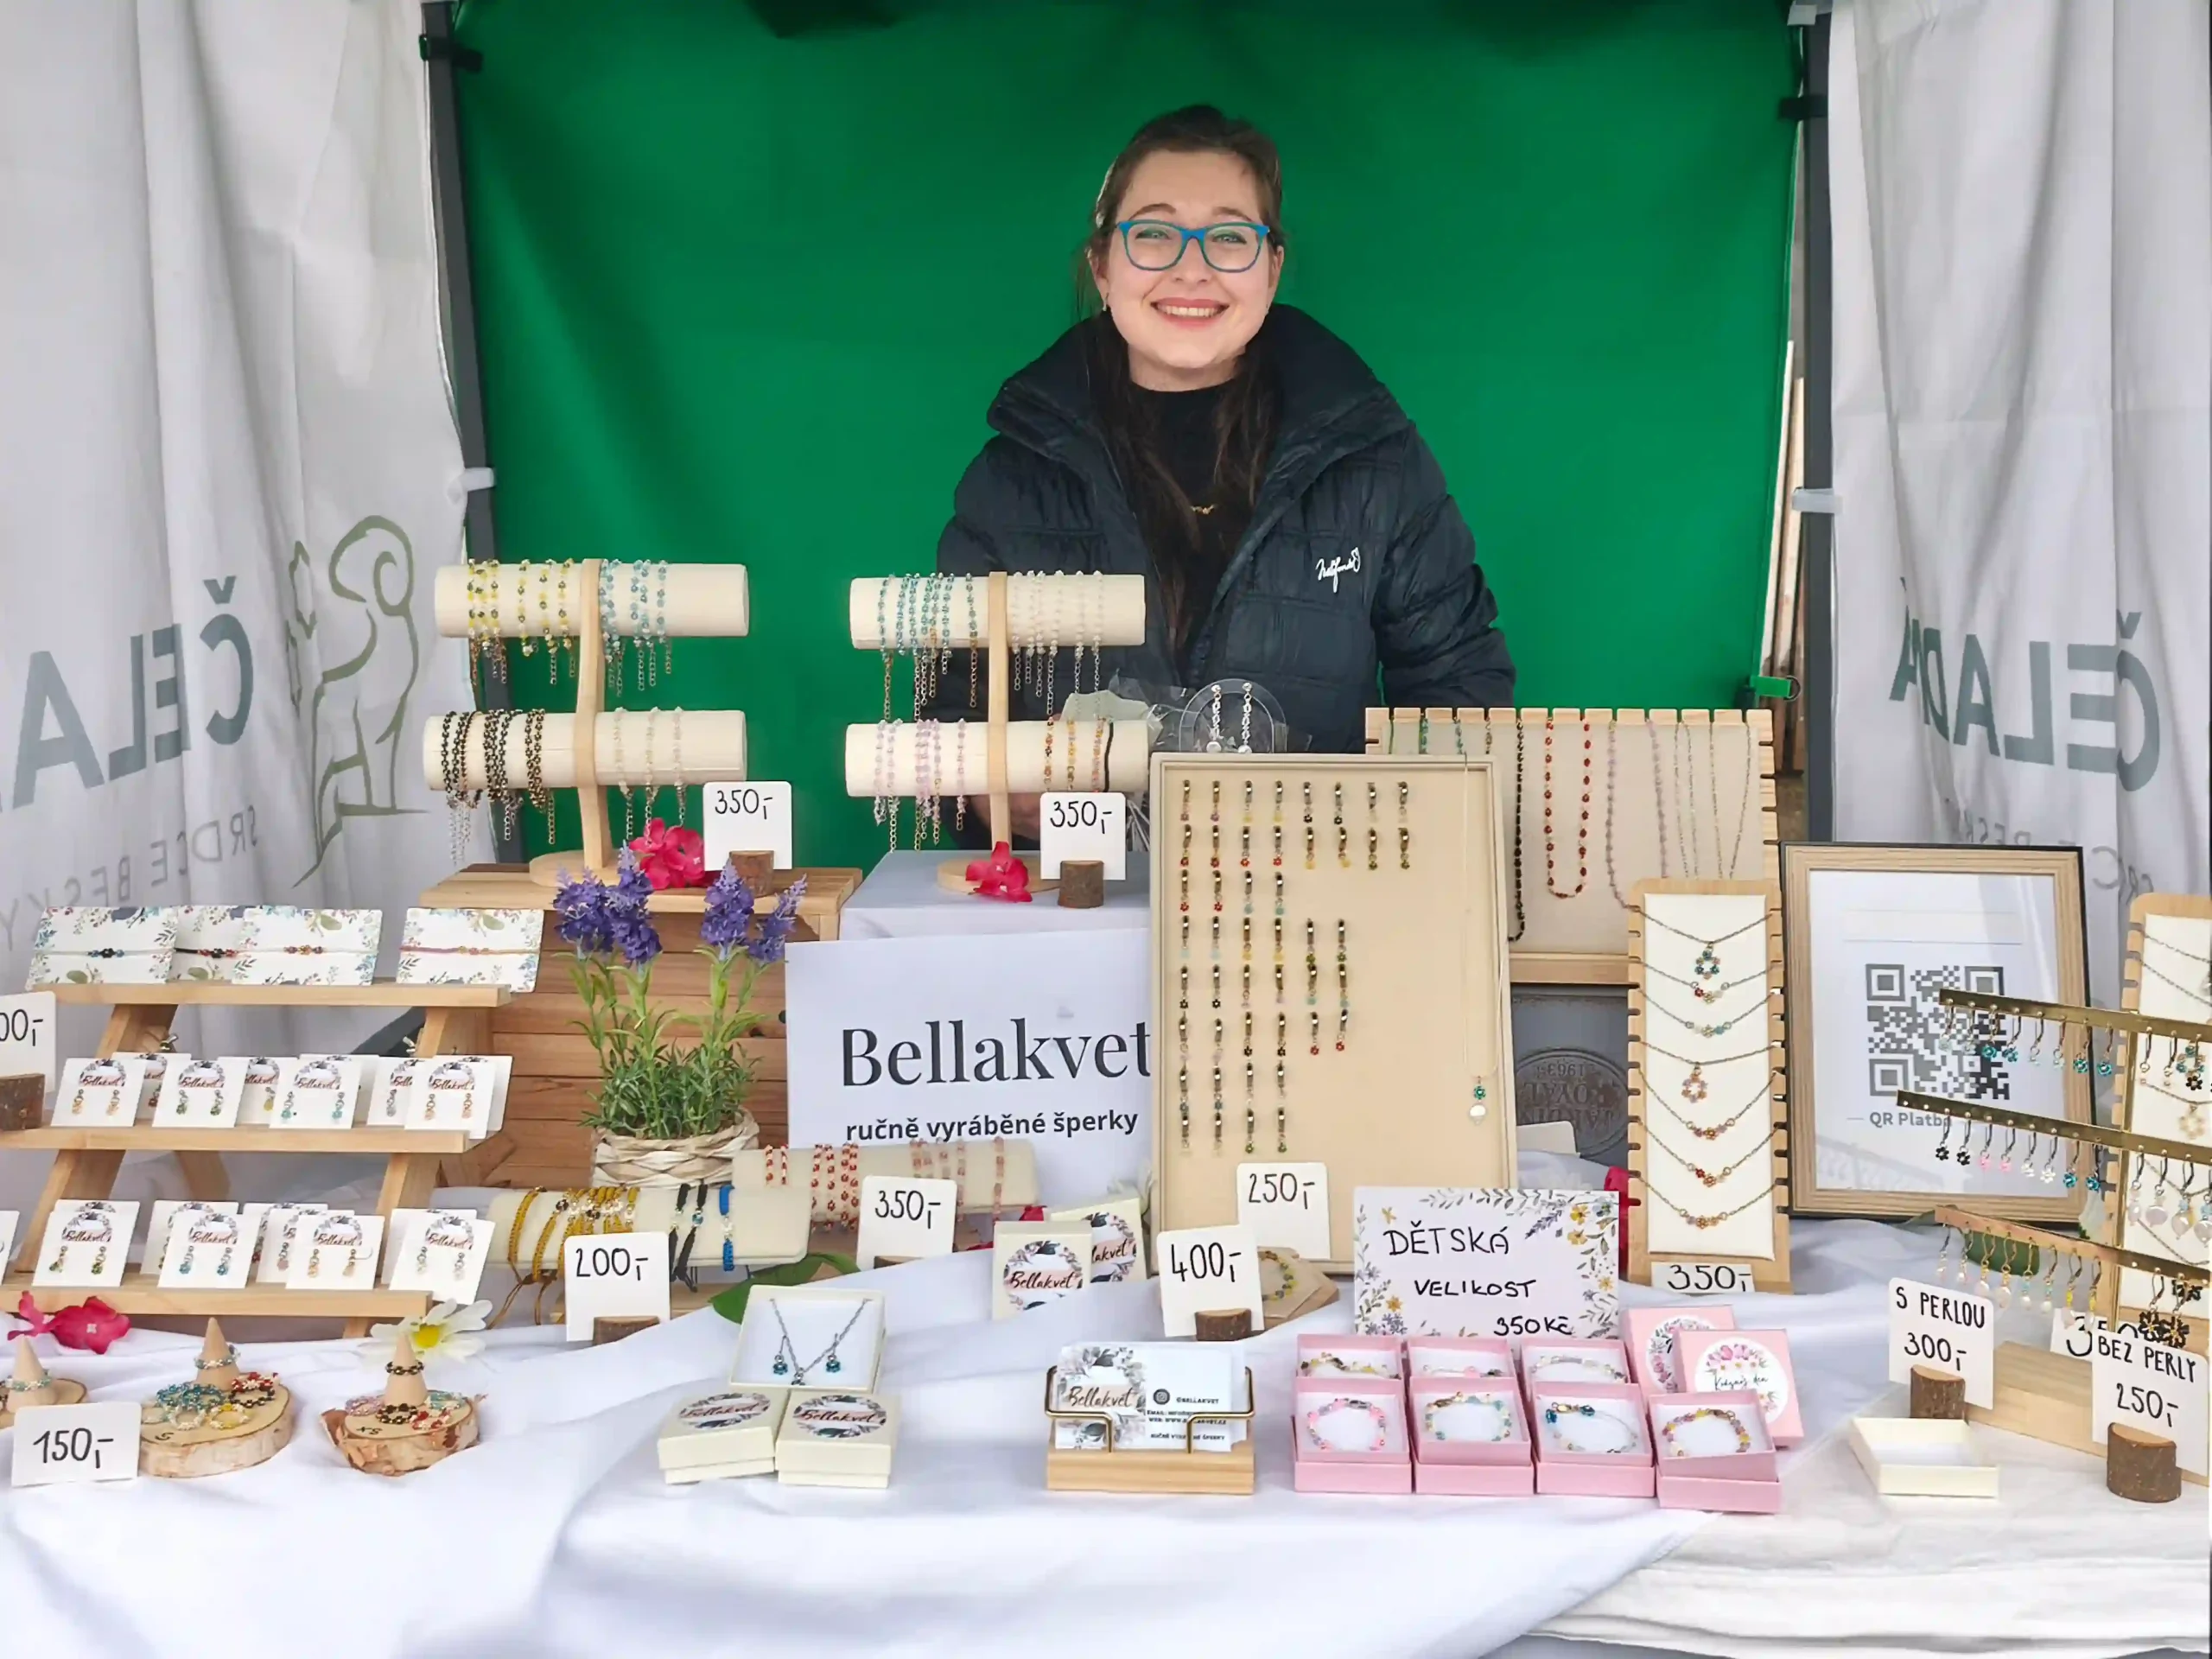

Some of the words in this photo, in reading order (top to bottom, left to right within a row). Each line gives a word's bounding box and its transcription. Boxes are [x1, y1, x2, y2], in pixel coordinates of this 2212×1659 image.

[715, 789, 773, 820] 350,-
[1050, 801, 1113, 834] 350,-
[842, 1017, 1150, 1087] Bellakvet
[846, 1118, 919, 1141] ručně
[926, 1114, 1046, 1143] vyráběné
[1053, 1109, 1138, 1136] šperky
[1869, 1111, 1894, 1128] QR
[874, 1190, 941, 1229] 350,-
[1249, 1173, 1315, 1210] 250,-
[1382, 1220, 1510, 1255] DĚTSKÁ
[575, 1248, 648, 1281] 200,-
[1171, 1243, 1242, 1282] 400,-
[1668, 1265, 1751, 1292] 350,-
[1414, 1279, 1536, 1298] VELIKOST
[1896, 1287, 1908, 1309] S
[1920, 1292, 1986, 1329] PERLOU
[1904, 1332, 1967, 1371] 300,-
[2098, 1335, 2133, 1363] BEZ
[2144, 1346, 2196, 1383] PERLY
[2116, 1382, 2179, 1427] 250,-
[33, 1427, 114, 1469] 150,-
